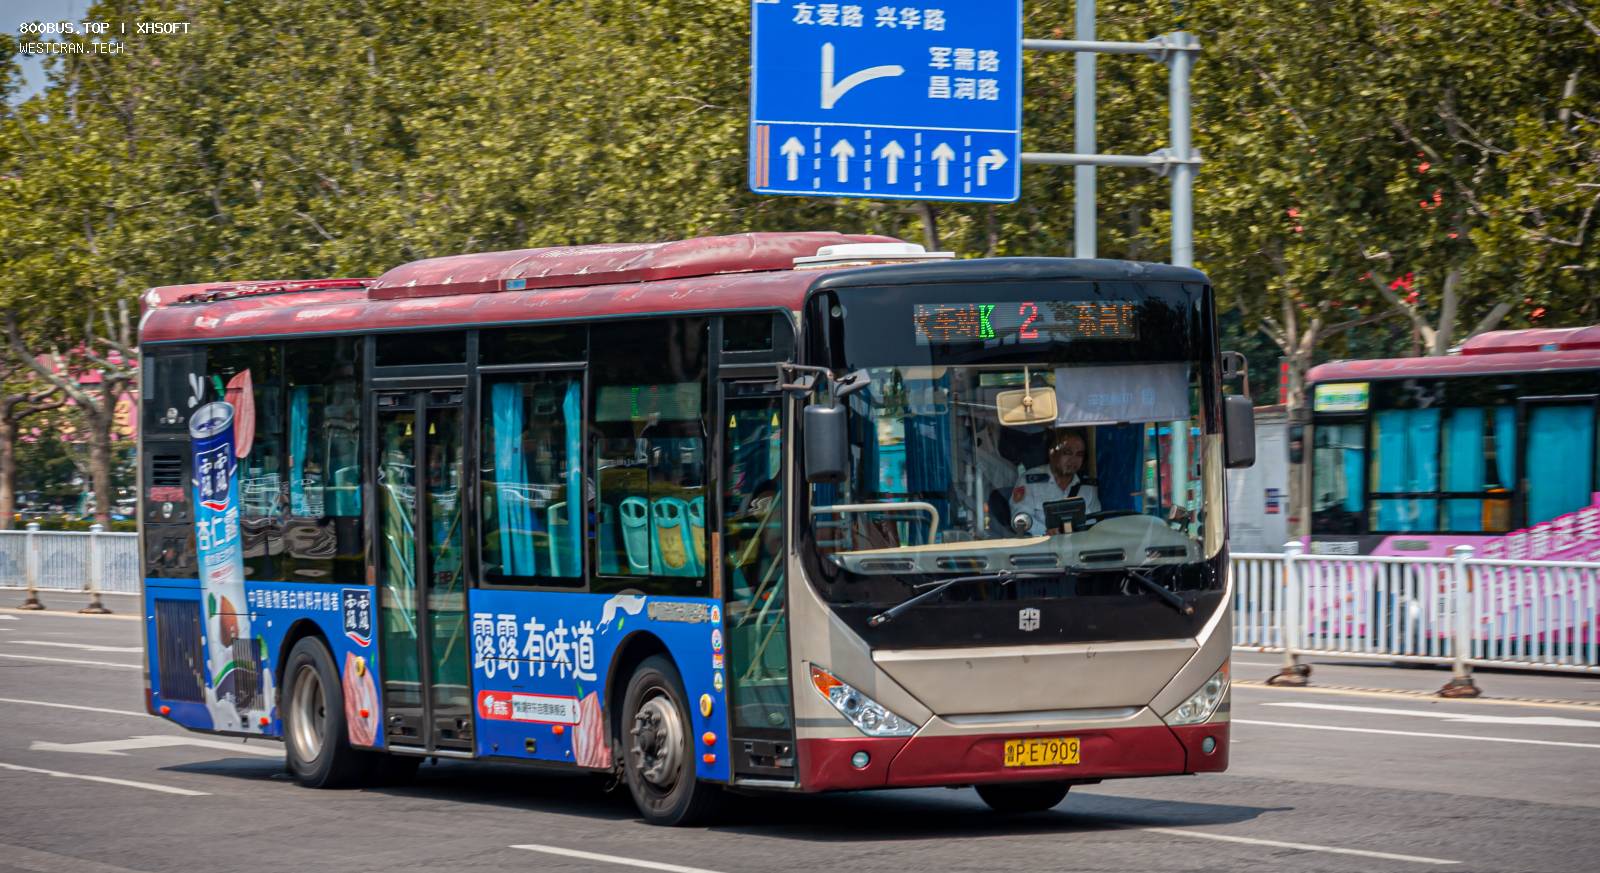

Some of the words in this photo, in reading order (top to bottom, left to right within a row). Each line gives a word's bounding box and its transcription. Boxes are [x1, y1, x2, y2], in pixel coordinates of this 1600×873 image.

[792, 3, 864, 28] 友爱路
[874, 6, 947, 31] 兴华路
[928, 47, 1000, 72] 军需路
[928, 75, 1000, 101] 昌润路
[979, 304, 995, 338] K
[1018, 302, 1038, 339] 2
[197, 507, 239, 551] 杏仁露
[248, 589, 339, 611] 中国植物蛋白饮料开创者
[473, 612, 598, 681] 露露有味道
